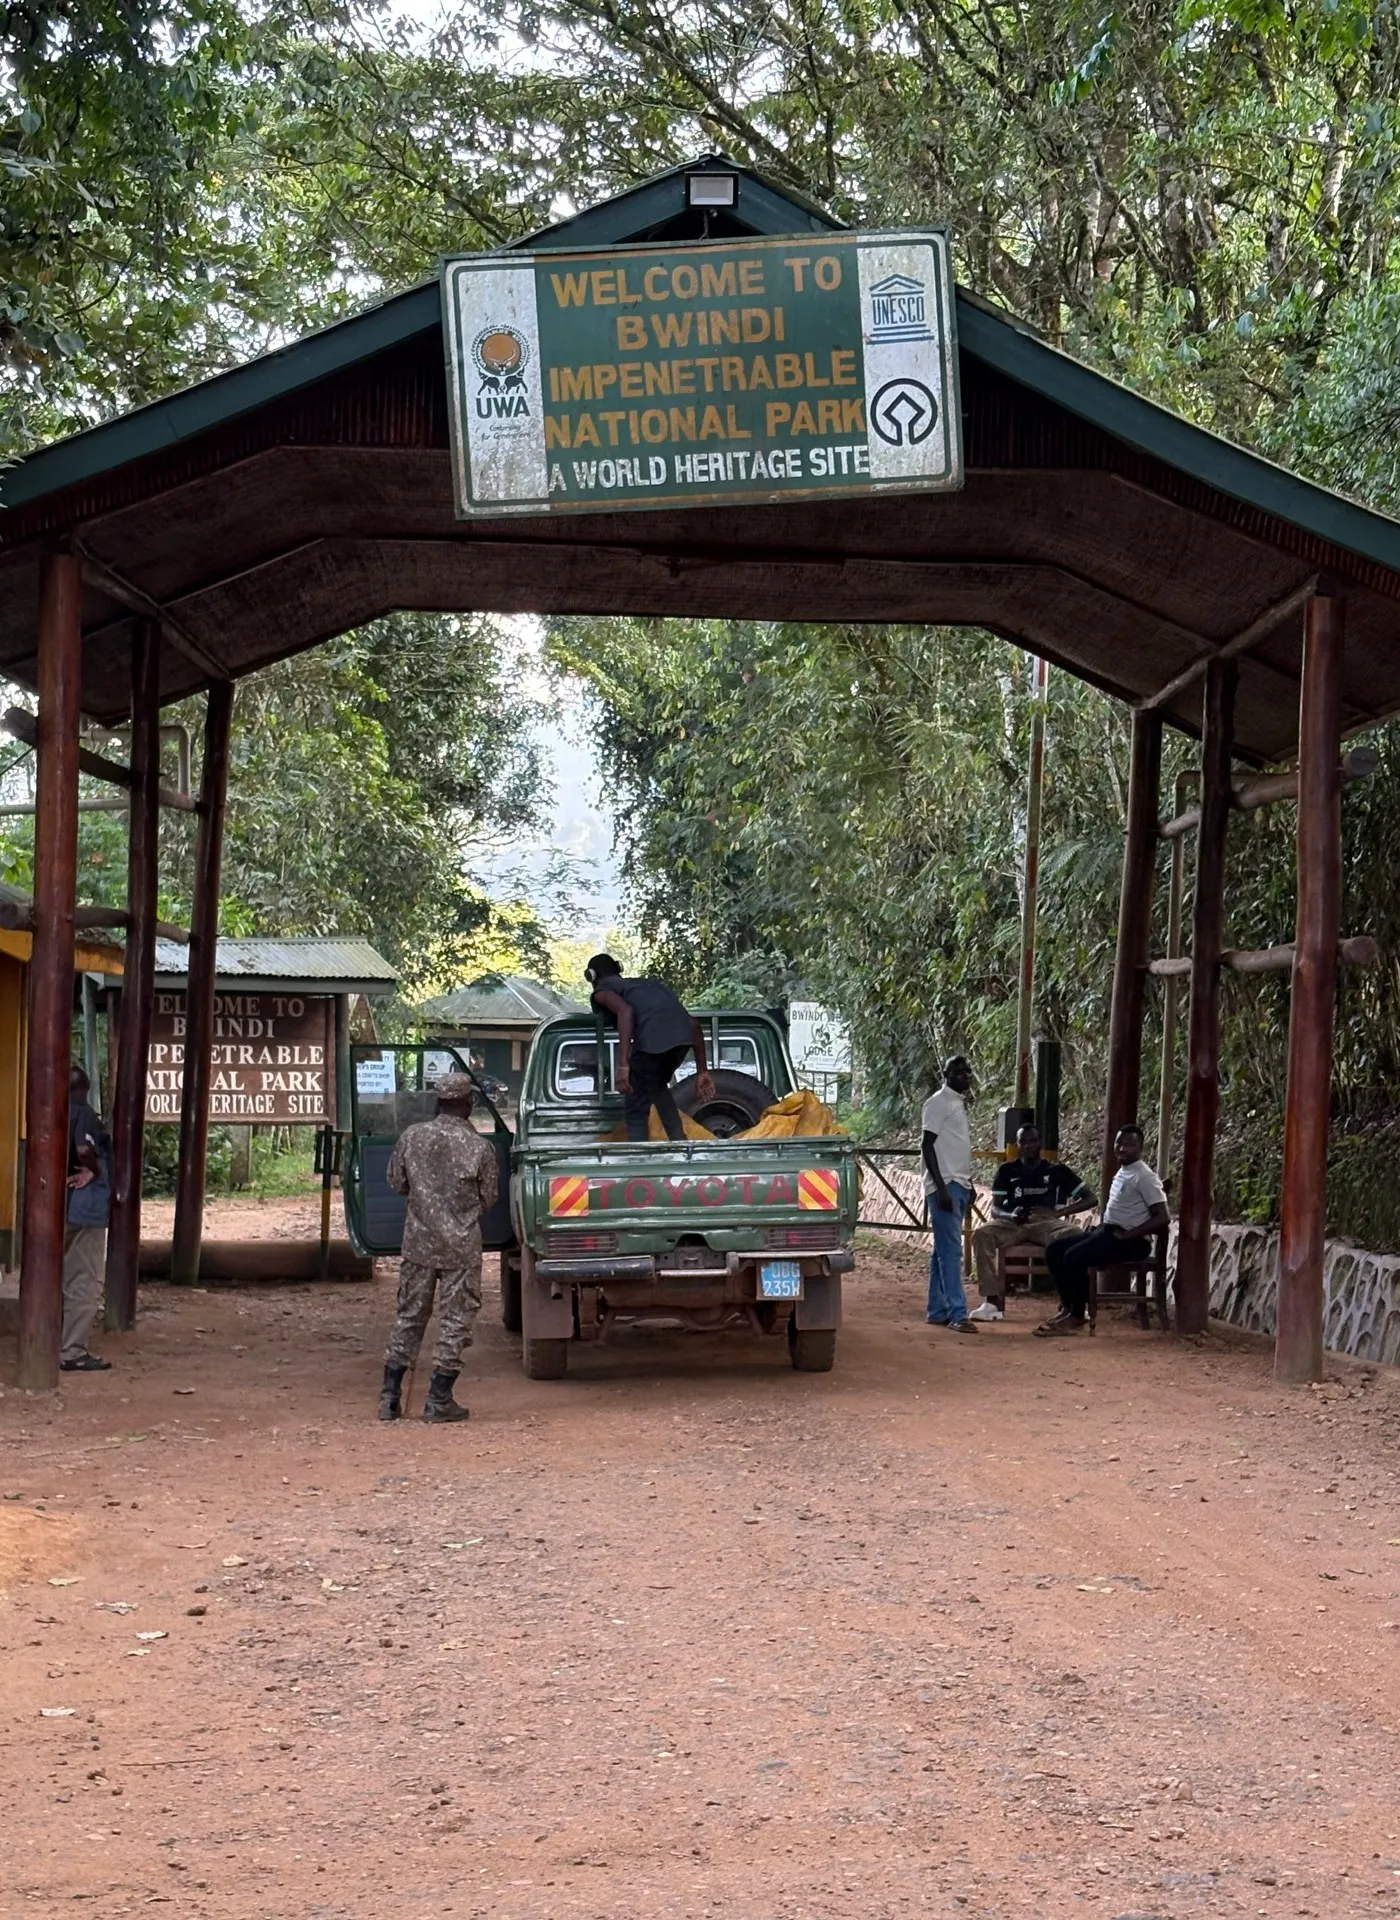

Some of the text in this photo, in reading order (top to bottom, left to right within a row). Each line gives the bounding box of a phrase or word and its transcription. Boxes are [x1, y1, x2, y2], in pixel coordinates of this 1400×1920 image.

[550, 256, 842, 308] WELCOME TO
[872, 296, 925, 325] UNESCO
[617, 307, 785, 350] BWINDI
[550, 350, 857, 402] IMPENETRABLE
[476, 396, 531, 419] UWA
[544, 398, 866, 449] NATIONAL PARK
[549, 445, 870, 491] A WORLD HERITAGE SITE
[158, 995, 305, 1017] ELOME TO
[172, 1016, 275, 1038] BINDI
[148, 1043, 324, 1065] PEETRABLE
[261, 1071, 322, 1092] PARK
[145, 1094, 324, 1114] ORL ERITAGE SITE
[592, 1174, 798, 1209] TOYOTA
